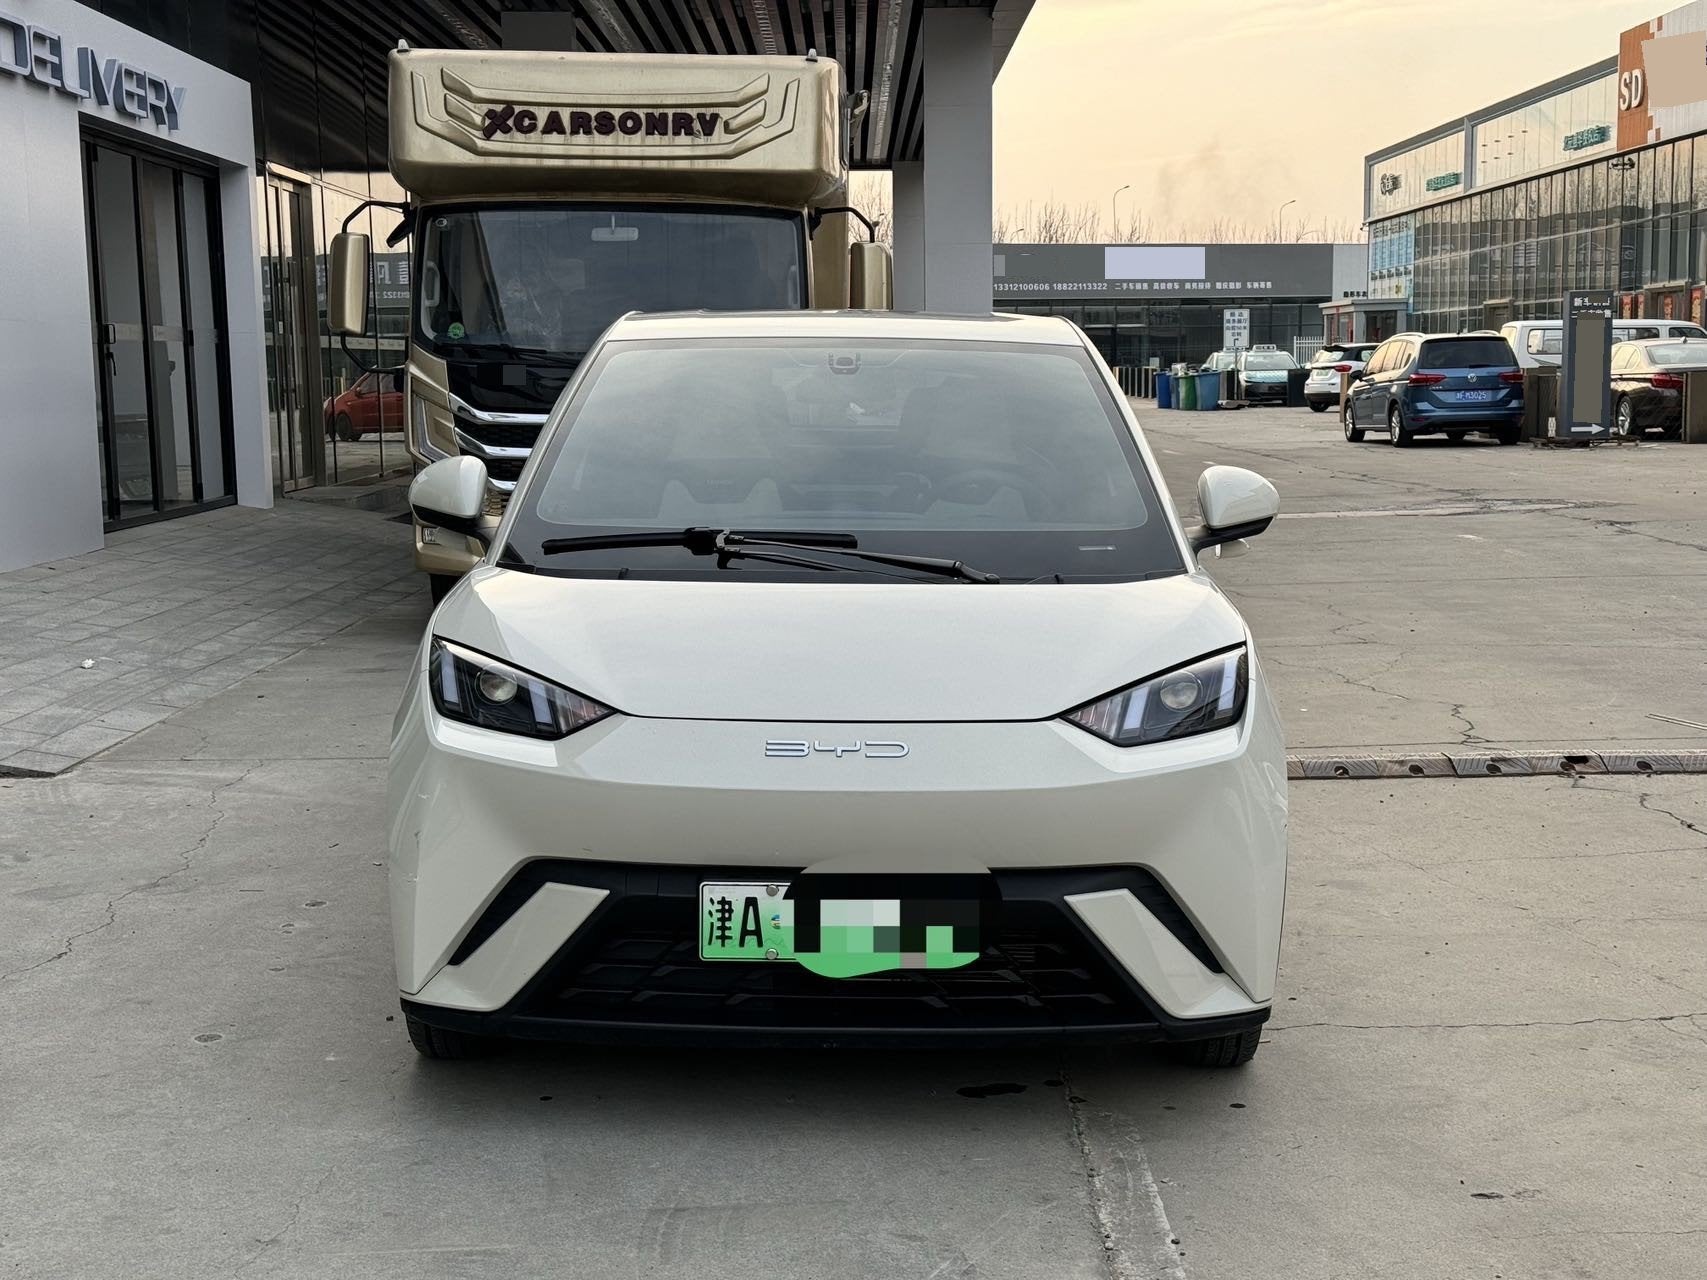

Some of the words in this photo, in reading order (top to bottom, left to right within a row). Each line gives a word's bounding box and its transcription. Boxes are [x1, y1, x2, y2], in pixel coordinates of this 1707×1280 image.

[0, 12, 187, 130] DELIVERY
[1620, 69, 1645, 111] SD
[765, 740, 910, 758] BYD
